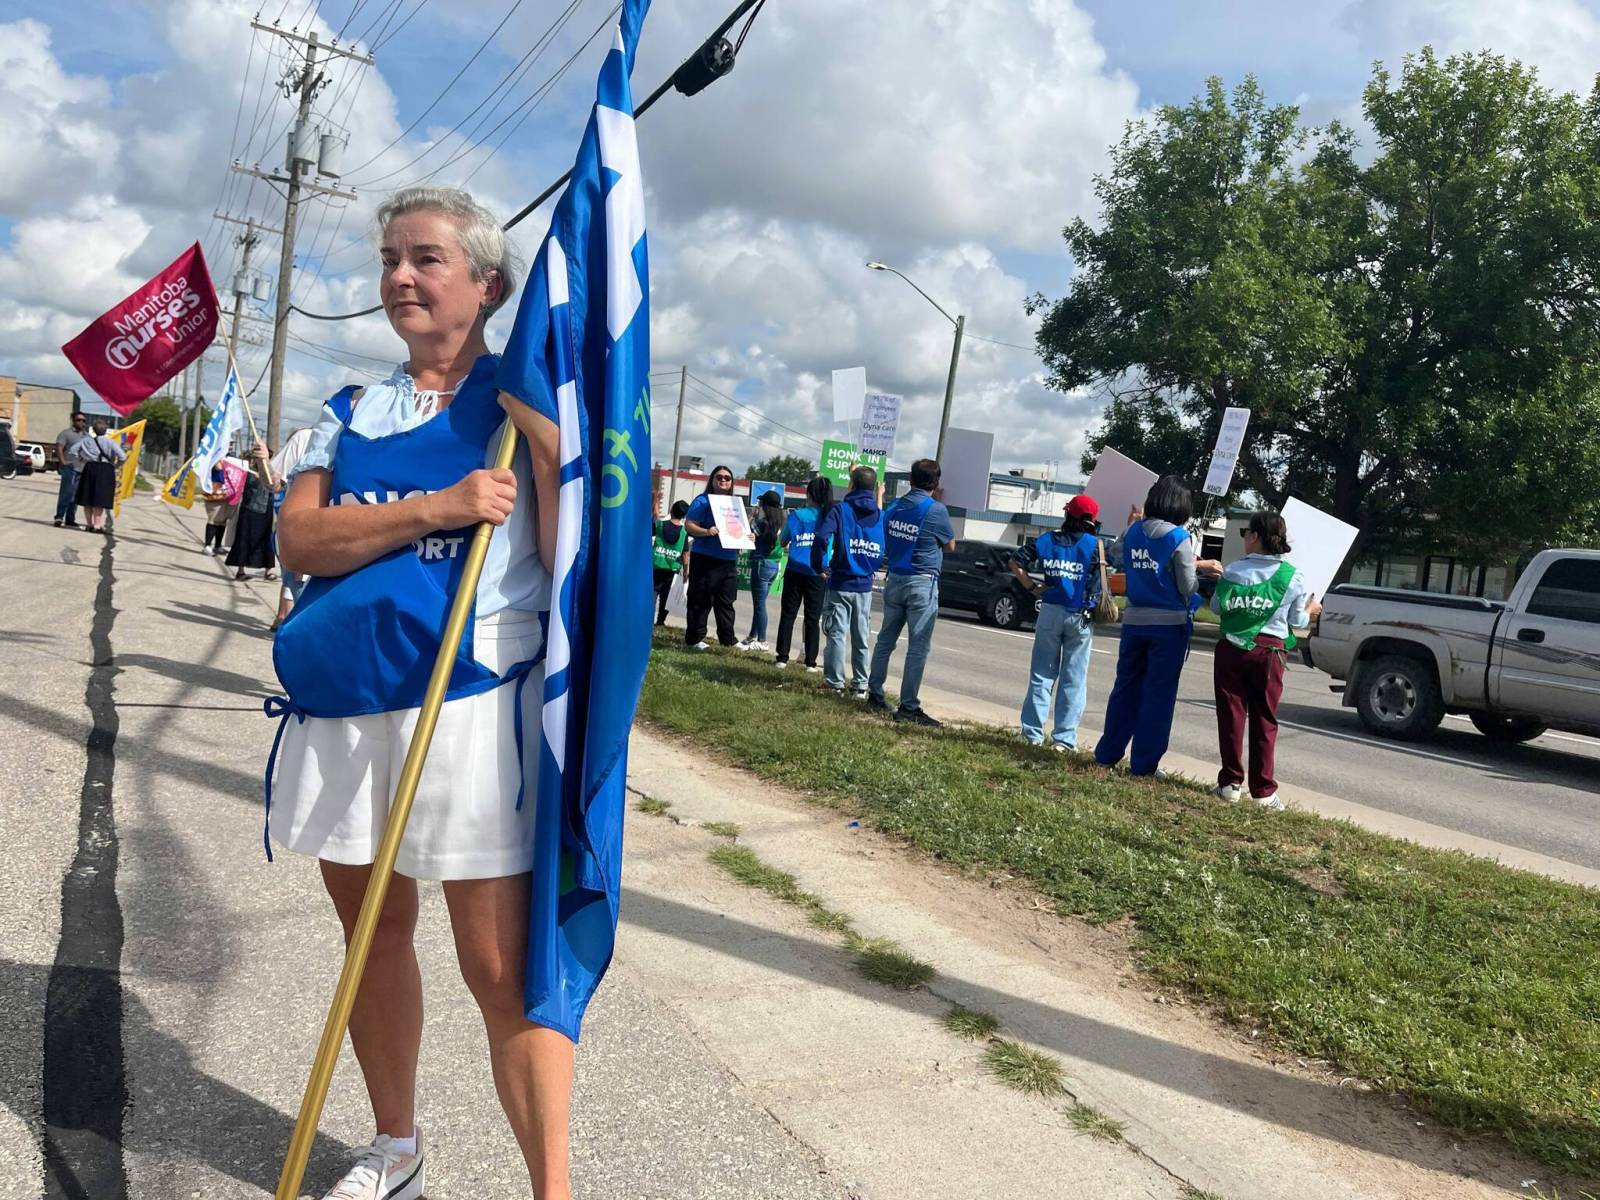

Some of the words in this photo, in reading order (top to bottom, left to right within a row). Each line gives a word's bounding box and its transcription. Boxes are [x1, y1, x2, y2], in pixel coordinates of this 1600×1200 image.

[113, 276, 188, 336] Manitoba
[107, 287, 201, 365] nurses
[828, 447, 862, 462] HONK
[867, 454, 880, 465] IN
[1051, 570, 1083, 581] SUPPORT
